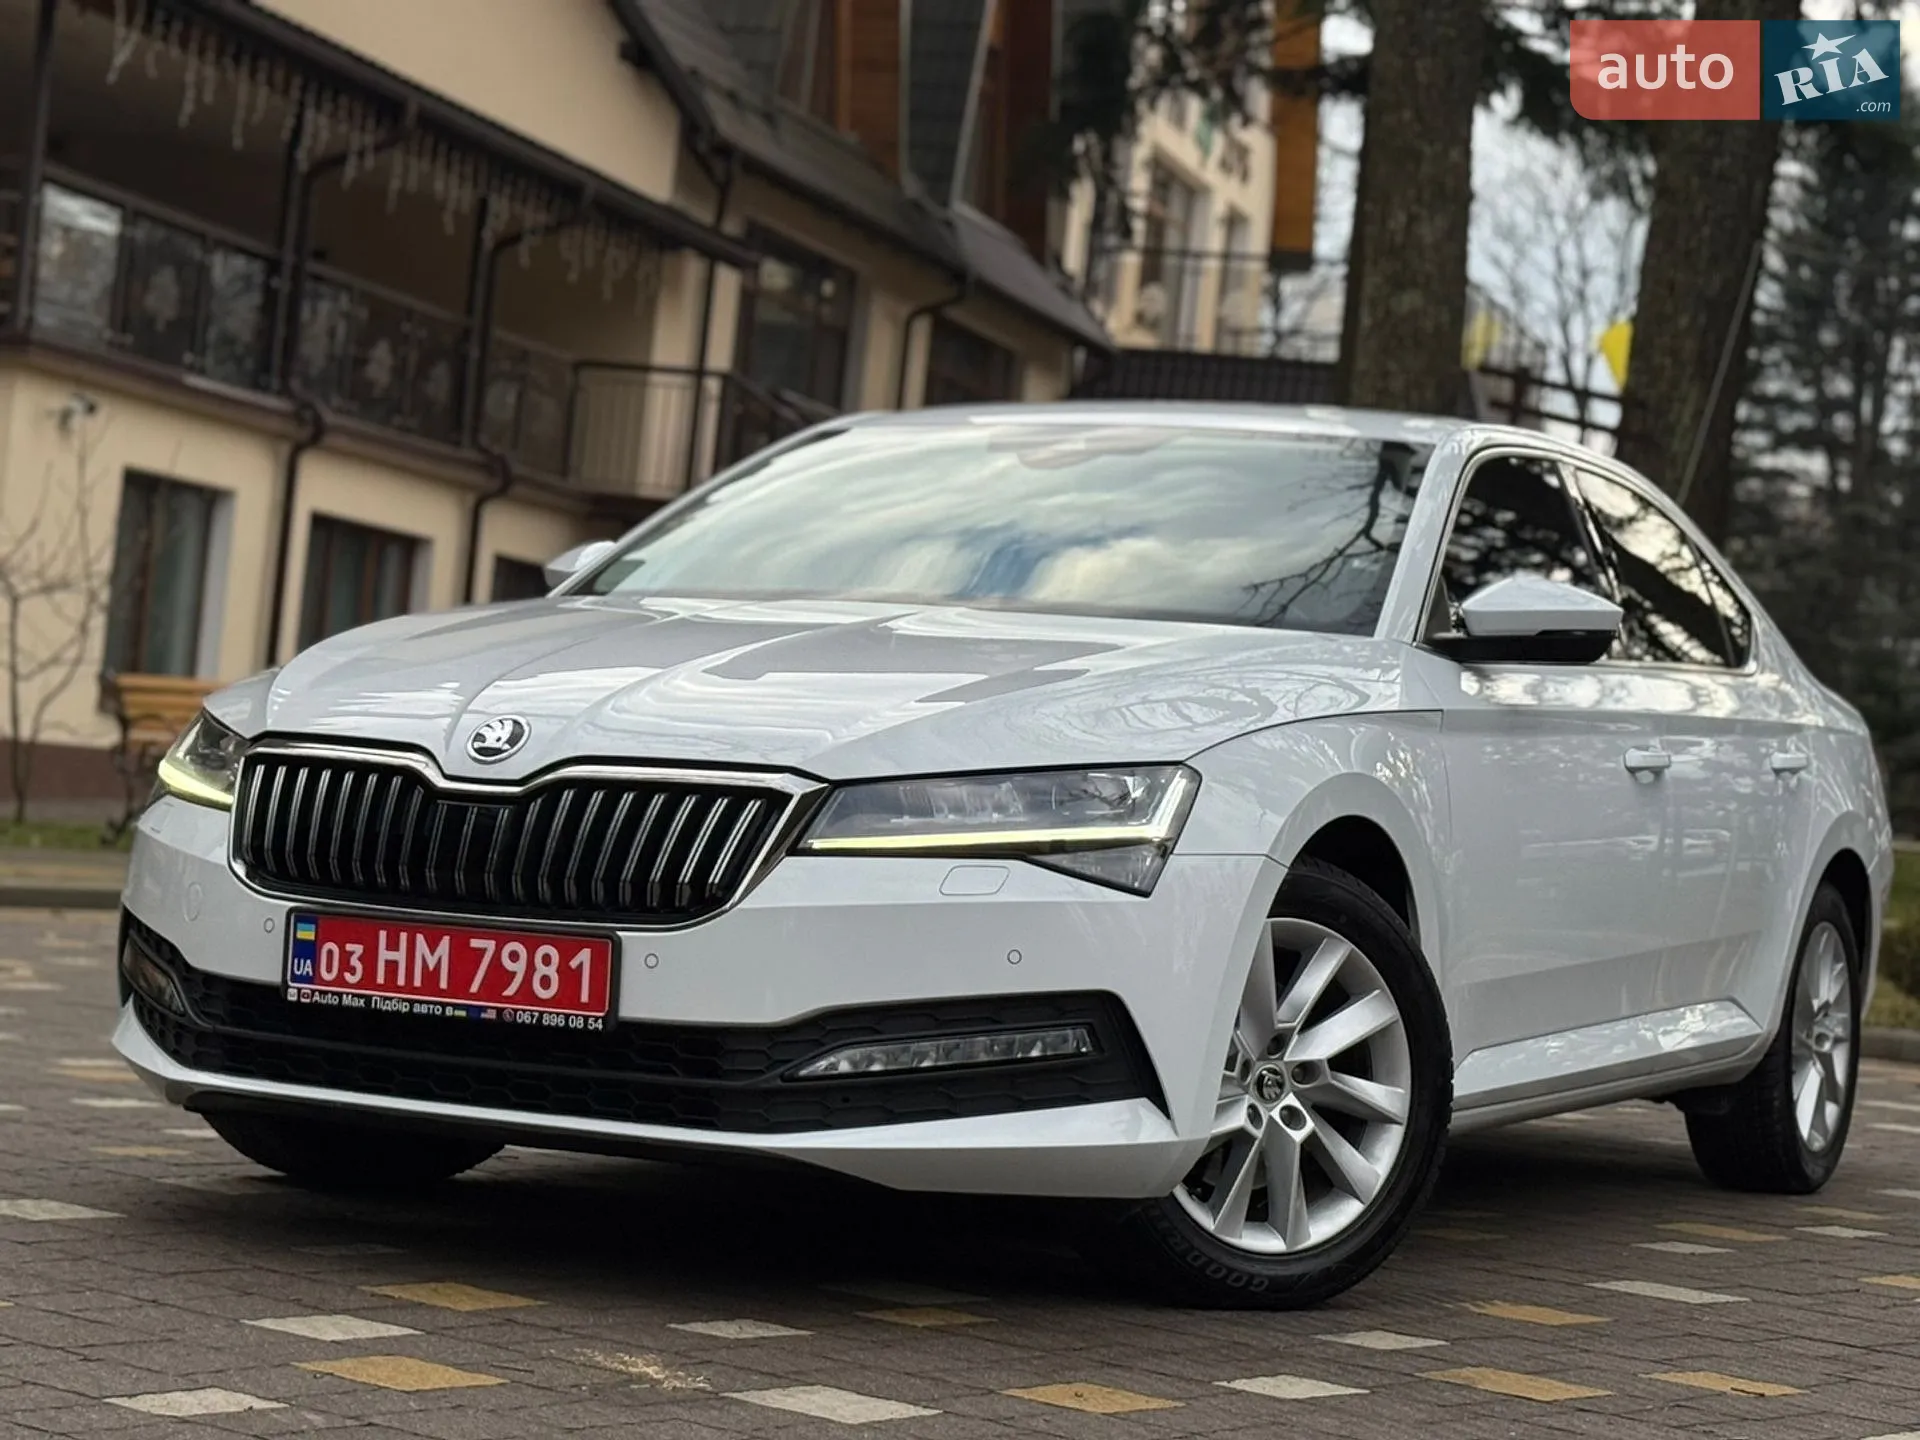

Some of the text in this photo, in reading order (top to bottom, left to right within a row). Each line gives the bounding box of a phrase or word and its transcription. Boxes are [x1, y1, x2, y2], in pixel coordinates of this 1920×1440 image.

[293, 960, 313, 977] UA
[319, 941, 364, 985] 03
[469, 938, 592, 1004] 7981
[312, 991, 339, 1006] Auto
[342, 993, 365, 1008] Max
[371, 996, 410, 1013] Підбір
[516, 1010, 538, 1024] 067
[542, 1012, 565, 1027] 896
[568, 1015, 584, 1029] 08
[588, 1017, 603, 1031] 54
